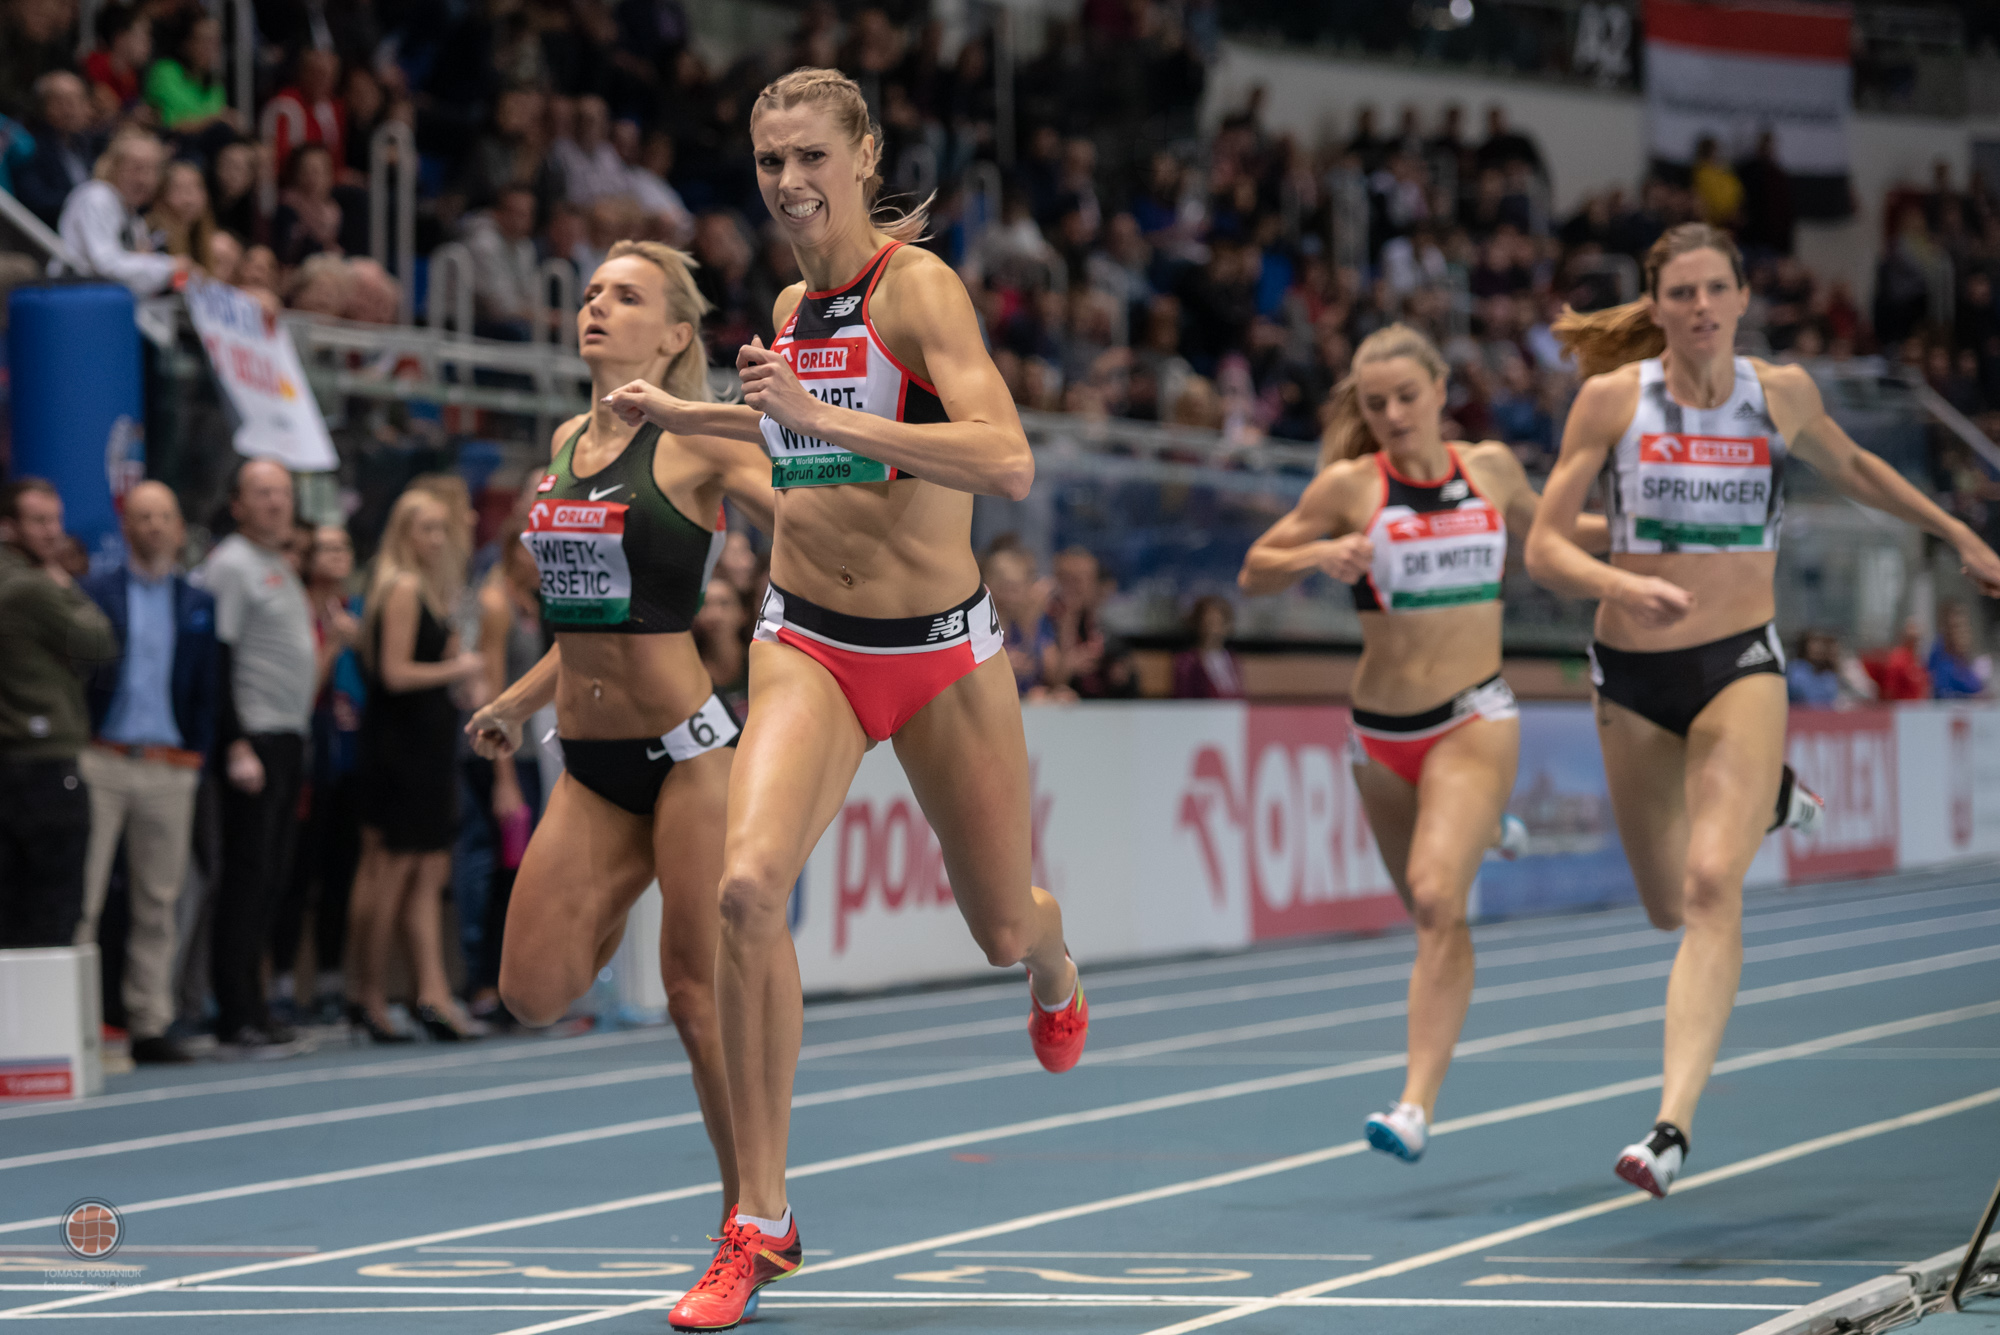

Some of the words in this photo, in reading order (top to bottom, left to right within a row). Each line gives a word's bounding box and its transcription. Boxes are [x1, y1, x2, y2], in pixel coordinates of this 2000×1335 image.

[800, 351, 844, 370] ORLEN
[796, 455, 814, 465] World
[815, 453, 836, 464] Indoor
[837, 452, 853, 463] Tour
[817, 463, 851, 479] 2019
[1642, 476, 1767, 503] SPRUNGER
[557, 511, 603, 524] ORLEN
[1404, 552, 1429, 576] DE
[688, 712, 715, 747] 6
